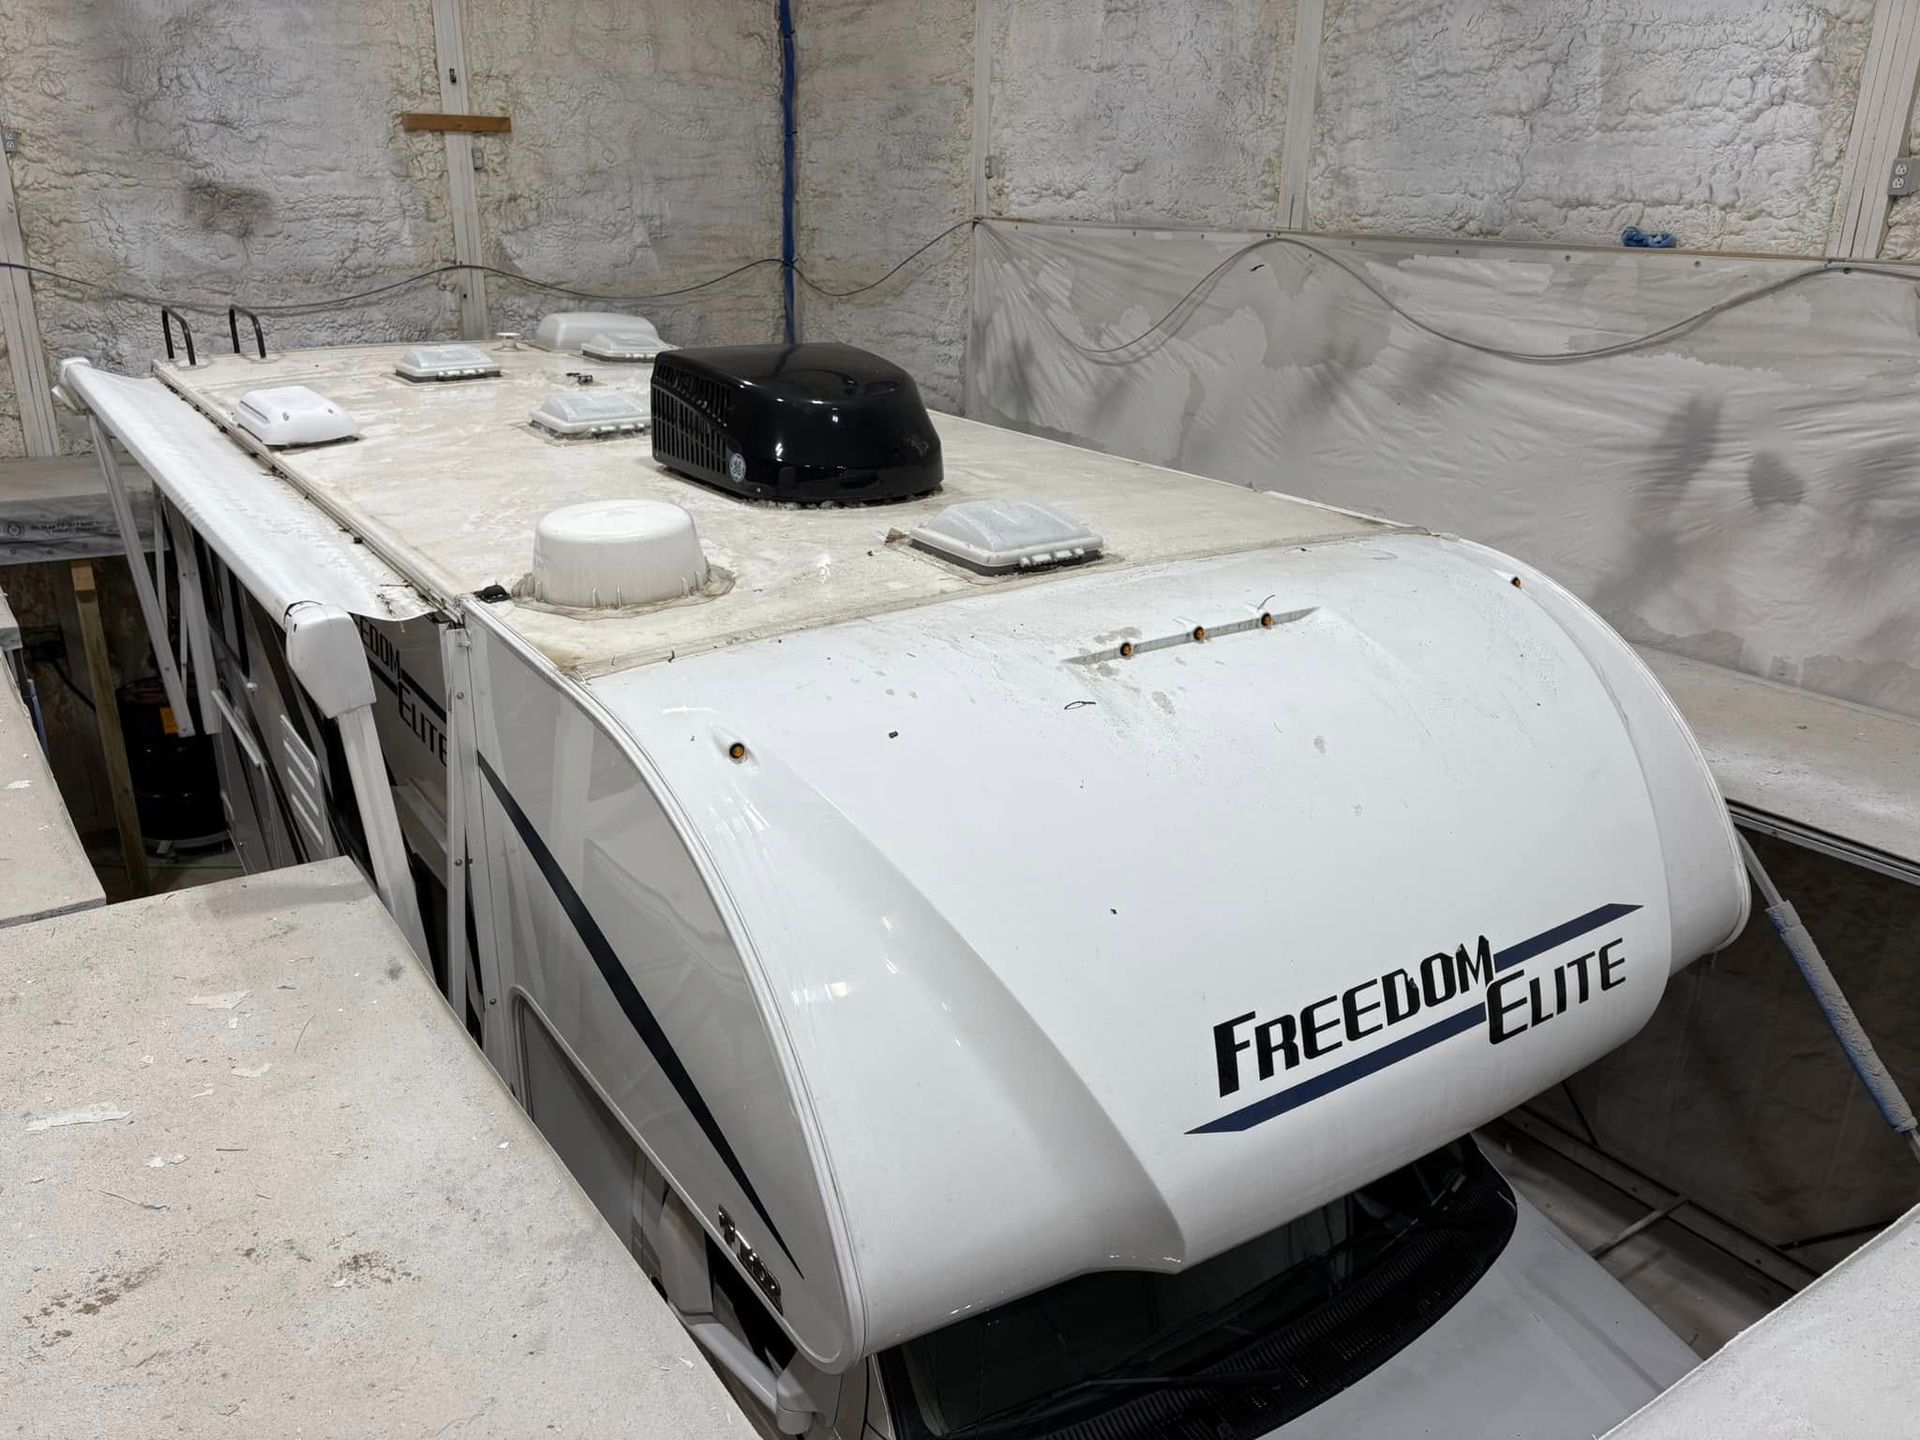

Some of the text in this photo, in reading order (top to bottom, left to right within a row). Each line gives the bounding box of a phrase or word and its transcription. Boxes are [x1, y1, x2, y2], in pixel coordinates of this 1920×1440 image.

[349, 614, 400, 680] EDOM
[1213, 934, 1494, 1098] FREEDOM
[1487, 937, 1626, 1045] ELITE
